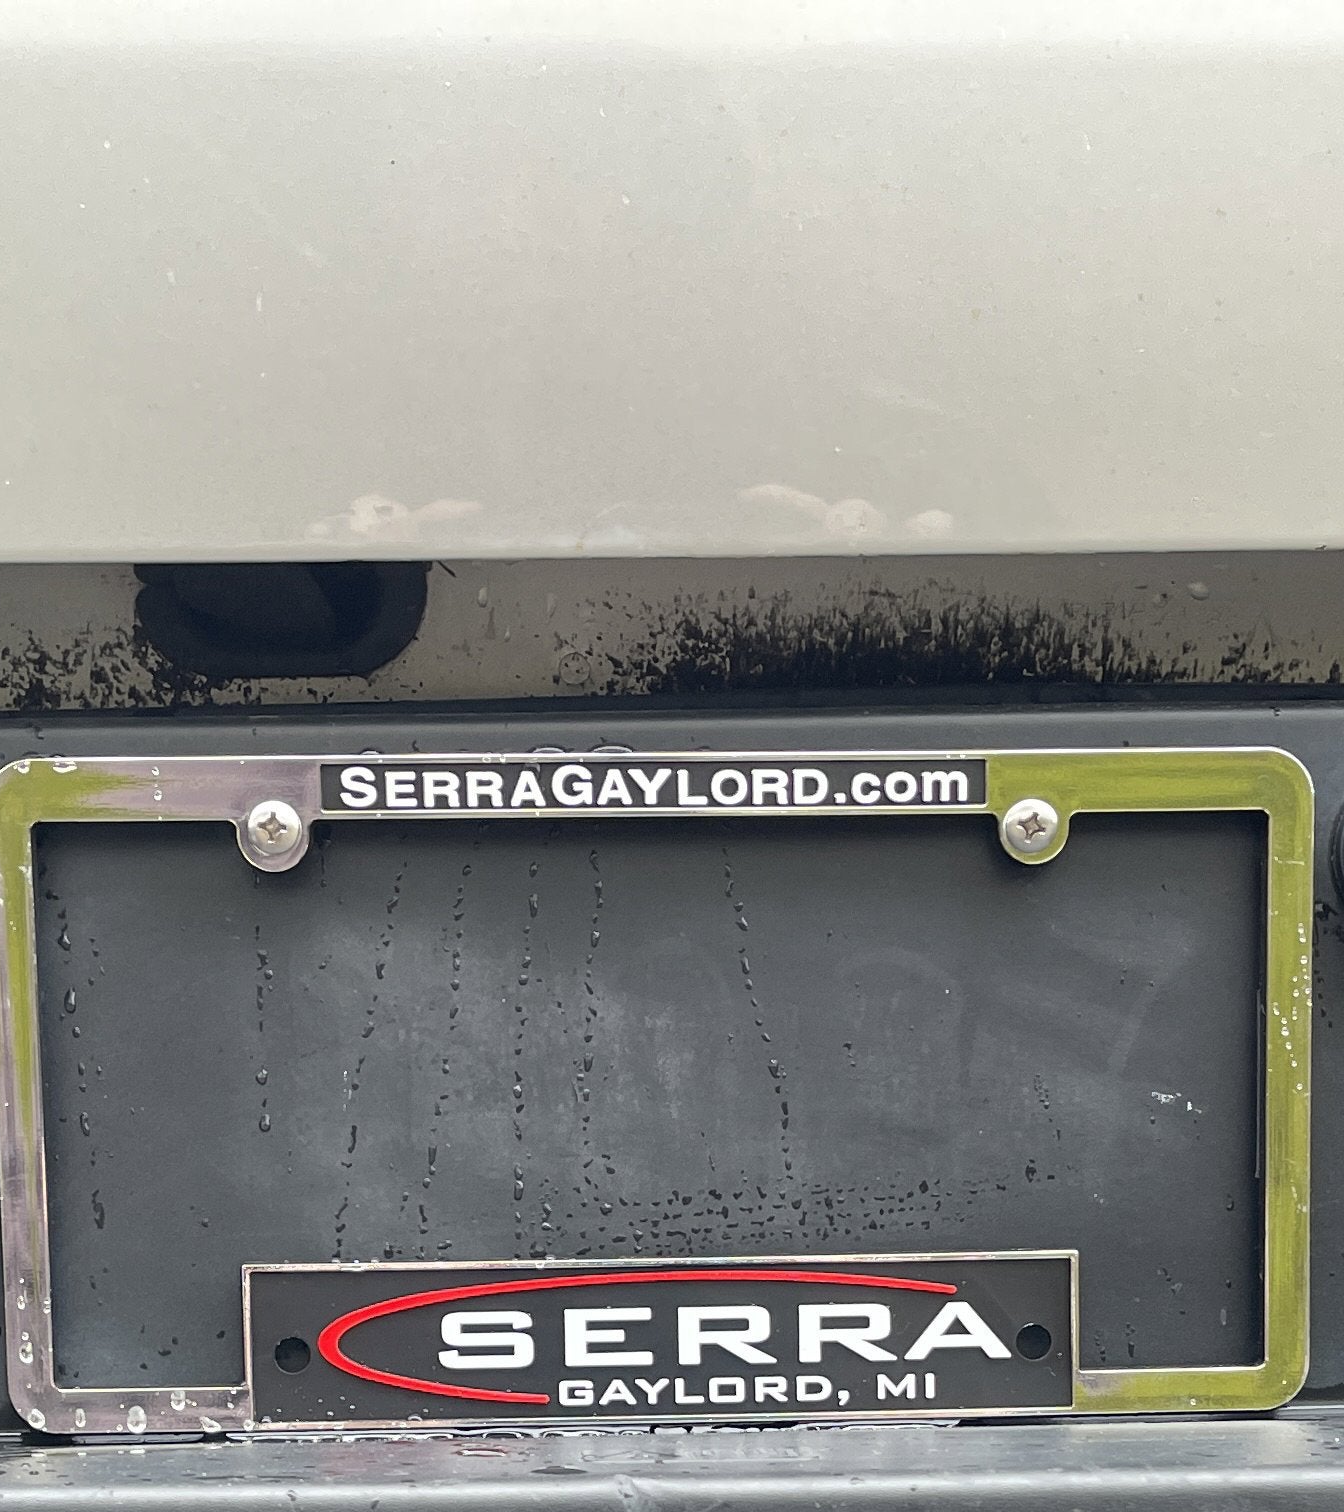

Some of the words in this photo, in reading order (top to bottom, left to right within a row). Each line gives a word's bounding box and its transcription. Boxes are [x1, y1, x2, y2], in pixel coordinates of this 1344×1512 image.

[339, 764, 970, 810] SERRAGAYLORD.com
[437, 1300, 1013, 1370] SERRA
[557, 1374, 851, 1408] GAYLORD,
[876, 1372, 937, 1401] MI
